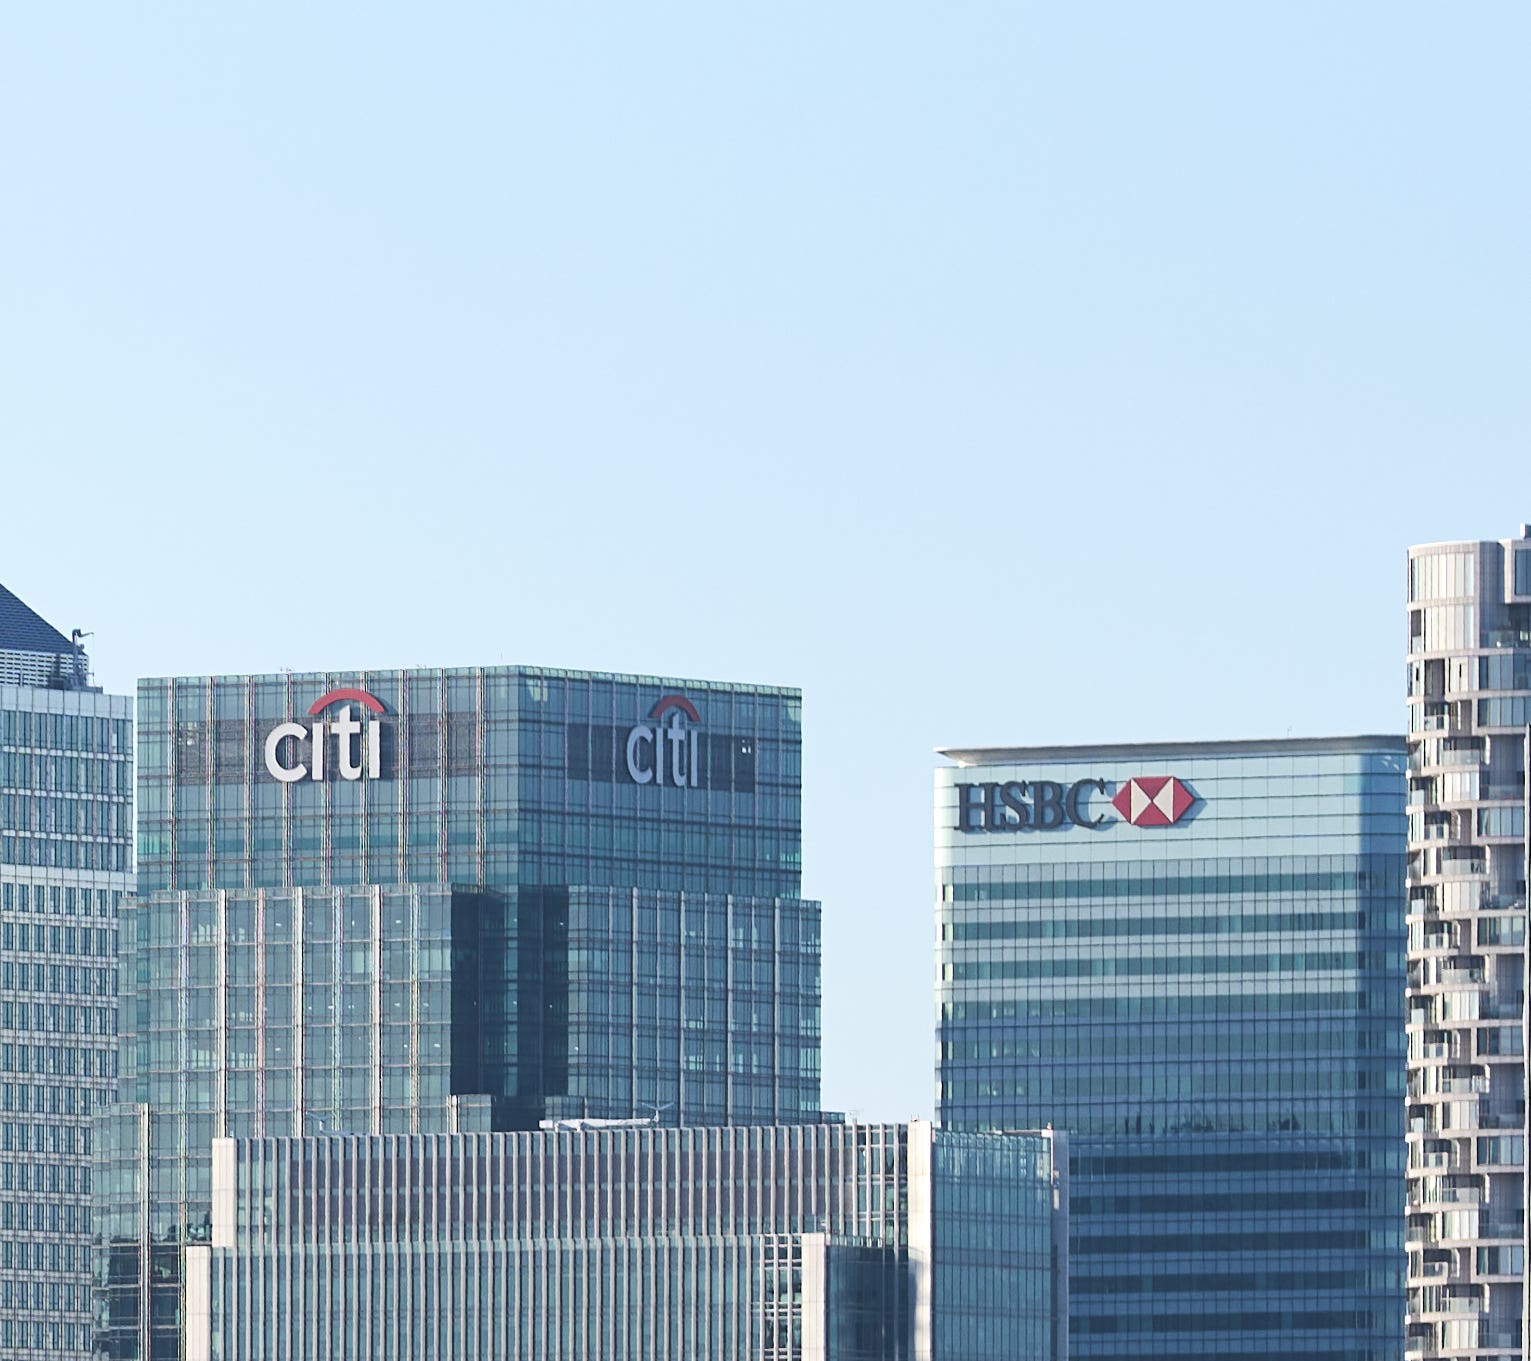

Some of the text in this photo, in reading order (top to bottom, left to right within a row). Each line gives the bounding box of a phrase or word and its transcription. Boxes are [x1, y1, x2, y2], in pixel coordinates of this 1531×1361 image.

[264, 704, 381, 781] citi
[626, 711, 700, 787] citi
[954, 777, 1106, 832] HSBC
